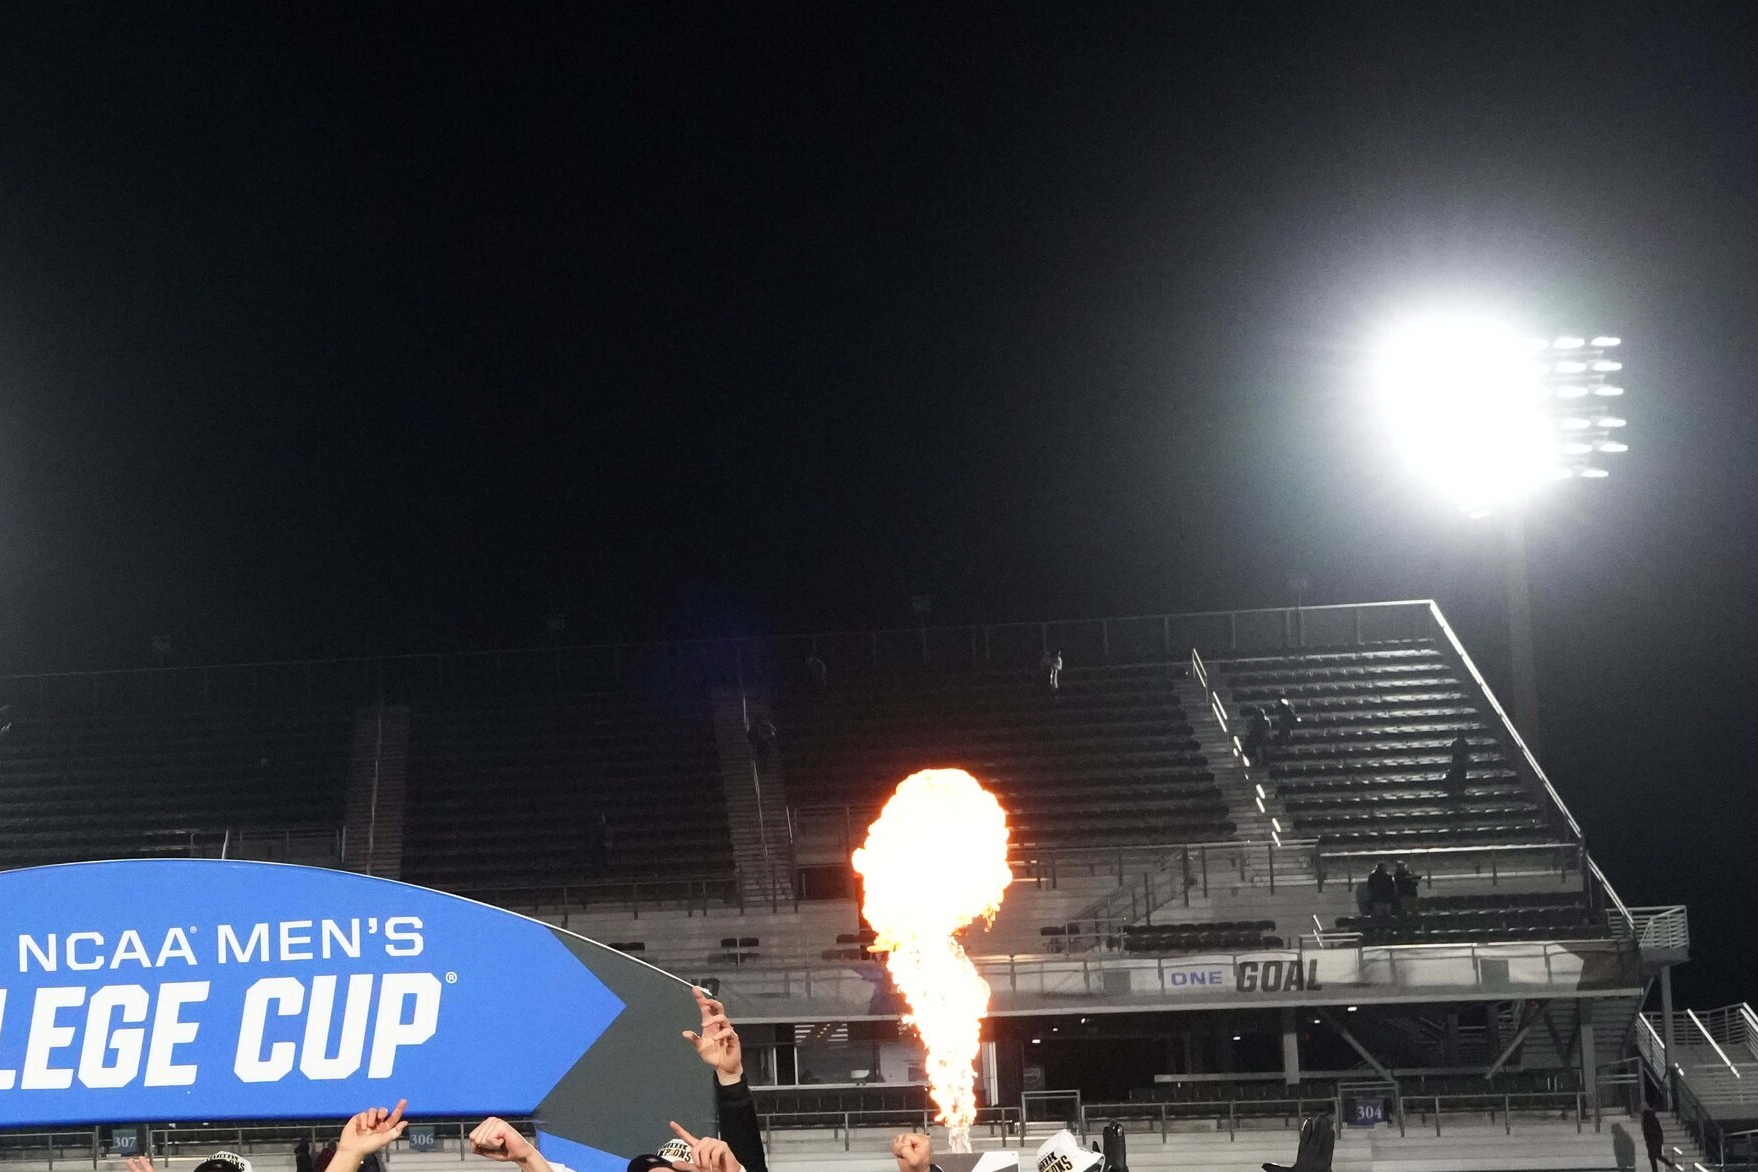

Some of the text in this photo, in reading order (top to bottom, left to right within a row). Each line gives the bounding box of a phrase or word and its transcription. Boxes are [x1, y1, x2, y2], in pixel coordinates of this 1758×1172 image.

[20, 928, 198, 971] NCAA
[218, 917, 424, 964] MEN'S
[1170, 958, 1323, 993] ONE GOAL
[233, 972, 442, 1083] CUP
[1356, 1104, 1383, 1121] 304
[113, 1135, 137, 1149] 307
[409, 1133, 435, 1147] 306
